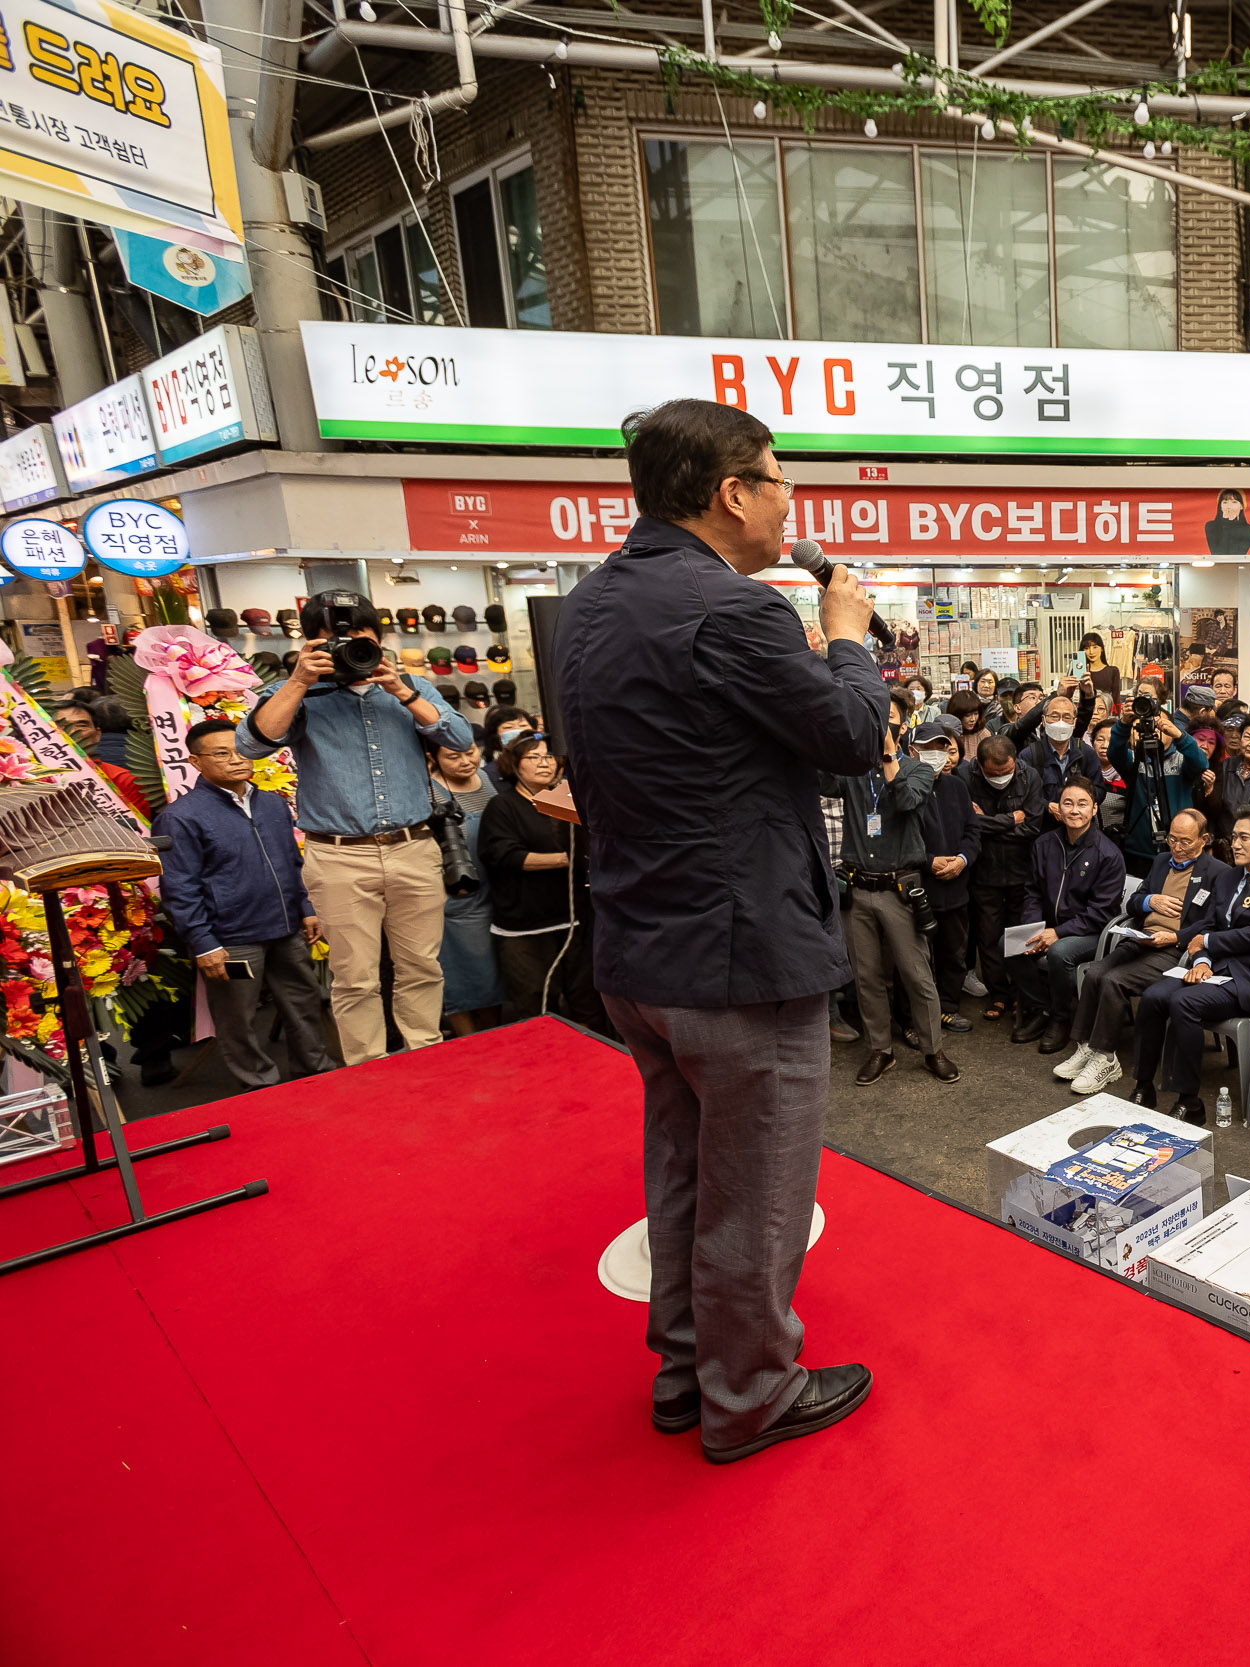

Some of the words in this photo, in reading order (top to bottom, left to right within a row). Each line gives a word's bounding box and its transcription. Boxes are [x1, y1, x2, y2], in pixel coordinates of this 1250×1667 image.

[23, 20, 172, 129] 드려요
[74, 125, 148, 169] 고객쉼터
[712, 353, 856, 416] BYC
[887, 360, 1072, 423] 직영점
[865, 467, 878, 477] 13
[454, 495, 486, 511] BYC
[108, 511, 163, 530] BYC
[908, 498, 1175, 546] BYC보디히트
[101, 533, 179, 555] 직영점
[459, 533, 489, 545] ARIN
[1182, 672, 1208, 680] NIGHT
[1135, 1224, 1159, 1244] 2023년
[1161, 1200, 1199, 1229] 자양전통시장
[1147, 1236, 1161, 1248] 맥주
[1163, 1218, 1188, 1239] 페스티벌
[1018, 1218, 1040, 1237] 2023년
[1041, 1231, 1081, 1258] 자양전통시장
